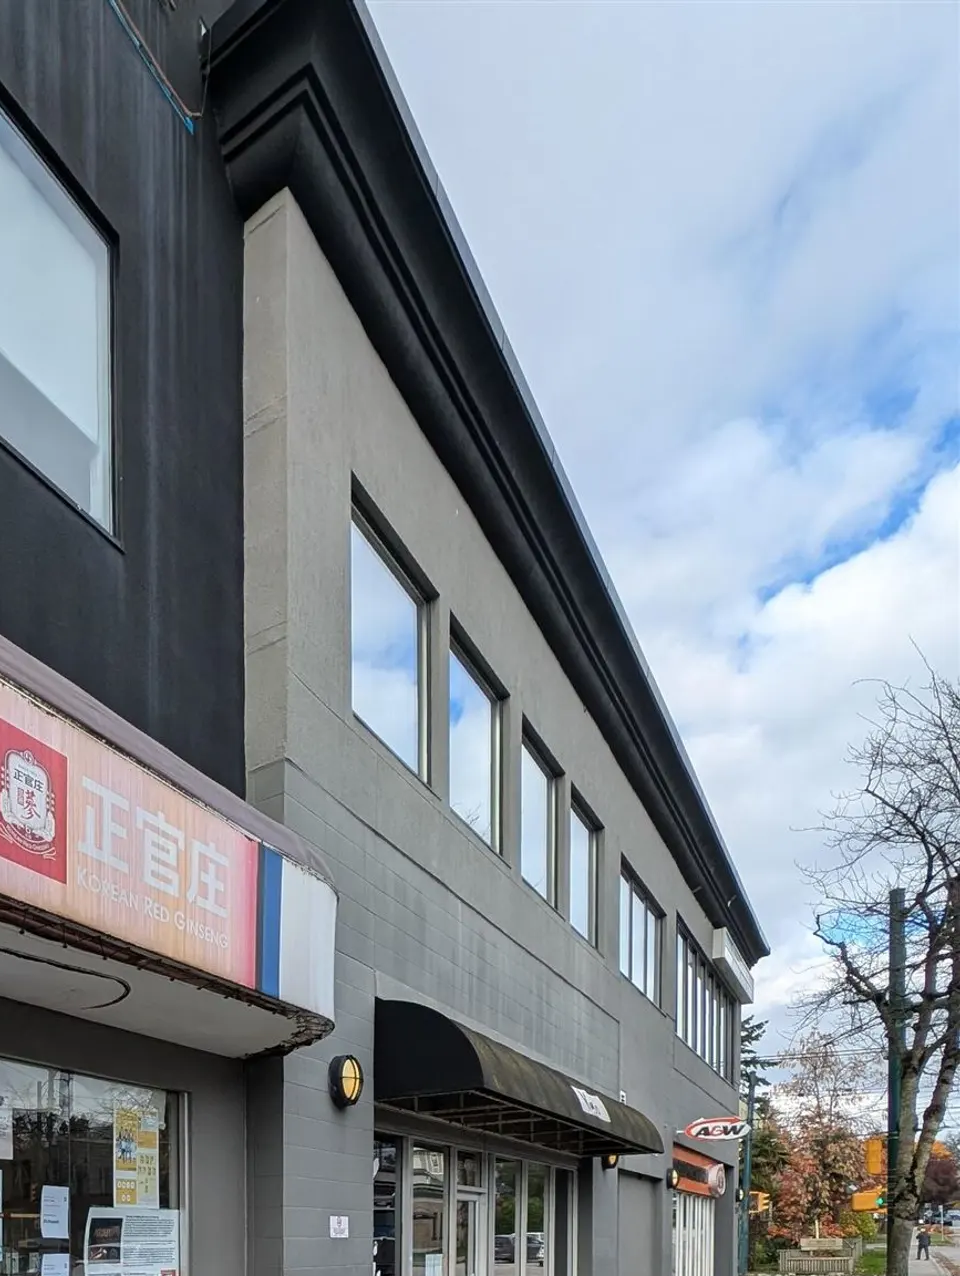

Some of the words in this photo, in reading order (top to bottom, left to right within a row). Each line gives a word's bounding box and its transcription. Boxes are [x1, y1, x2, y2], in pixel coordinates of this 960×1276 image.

[13, 768, 44, 793] 正官庄
[77, 775, 230, 919] 正官庄
[77, 866, 140, 911] KOREAN
[144, 898, 170, 923] RED
[174, 911, 229, 948] GINSENG
[695, 1124, 746, 1137] A&W
